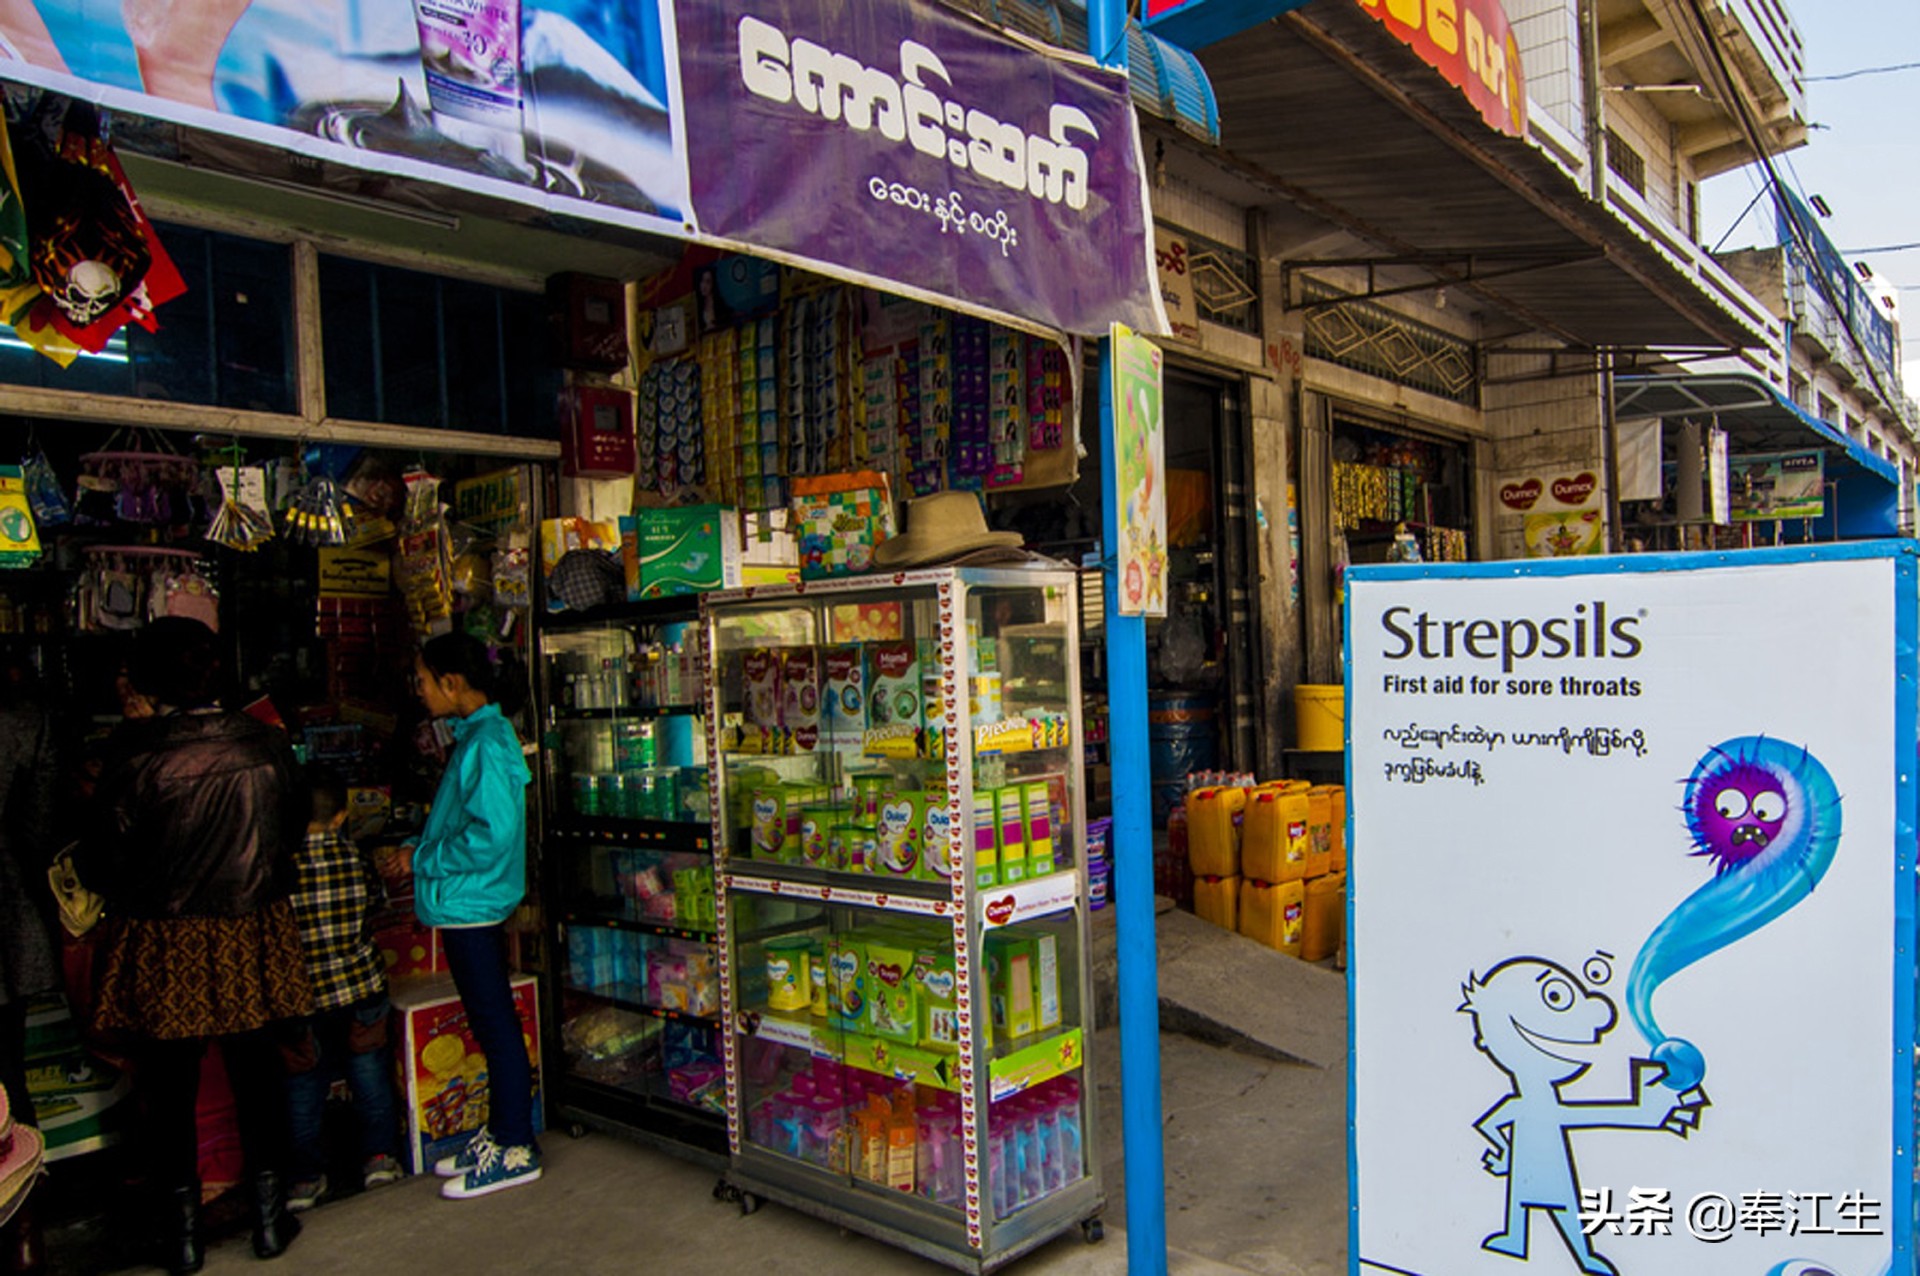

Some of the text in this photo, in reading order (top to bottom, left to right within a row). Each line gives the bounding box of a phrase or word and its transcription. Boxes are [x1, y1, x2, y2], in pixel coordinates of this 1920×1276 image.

[1381, 601, 1642, 673] Strepsils
[1384, 675, 1641, 696] First aid for sore throats
